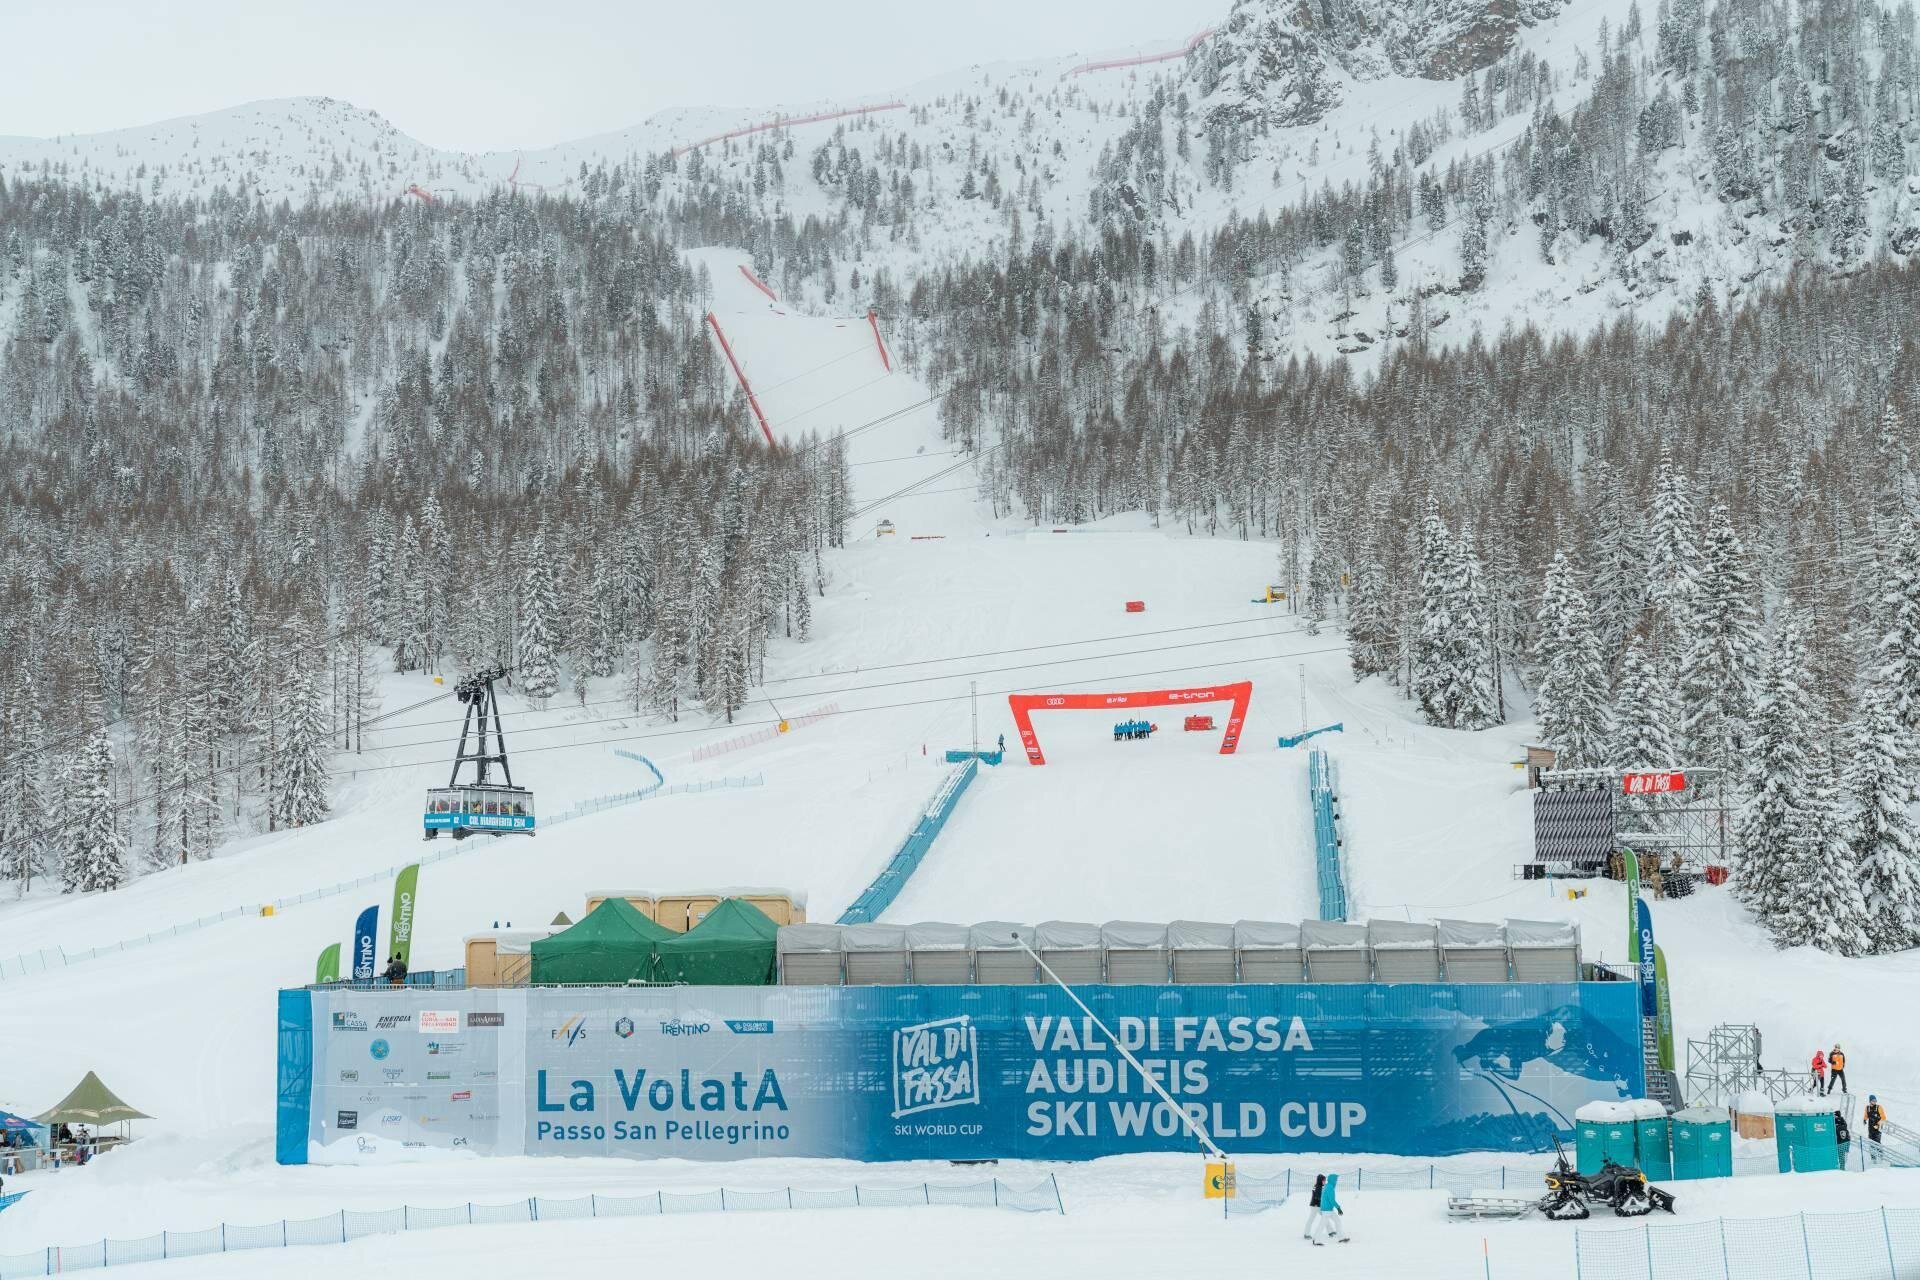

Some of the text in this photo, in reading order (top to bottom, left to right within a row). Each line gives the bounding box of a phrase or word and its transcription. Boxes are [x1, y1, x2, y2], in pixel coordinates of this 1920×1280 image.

[1168, 691, 1214, 700] e-tron
[395, 892, 411, 943] TRENTINO
[1641, 928, 1654, 986] TRENTINO
[379, 1015, 411, 1023] ENERGIA
[660, 1021, 710, 1036] TRENTINO
[1024, 1016, 1314, 1052] VAL DI FASSA
[902, 1029, 942, 1067] VAL
[537, 1068, 788, 1112] La VolatA
[902, 1060, 971, 1106] FASSA
[1025, 1058, 1209, 1095] AUDI FIS
[538, 1120, 790, 1145] Passo San Pellegrino
[894, 1125, 983, 1135] SKI WORLD CUP
[1026, 1101, 1367, 1138] SKI WORLD CUP
